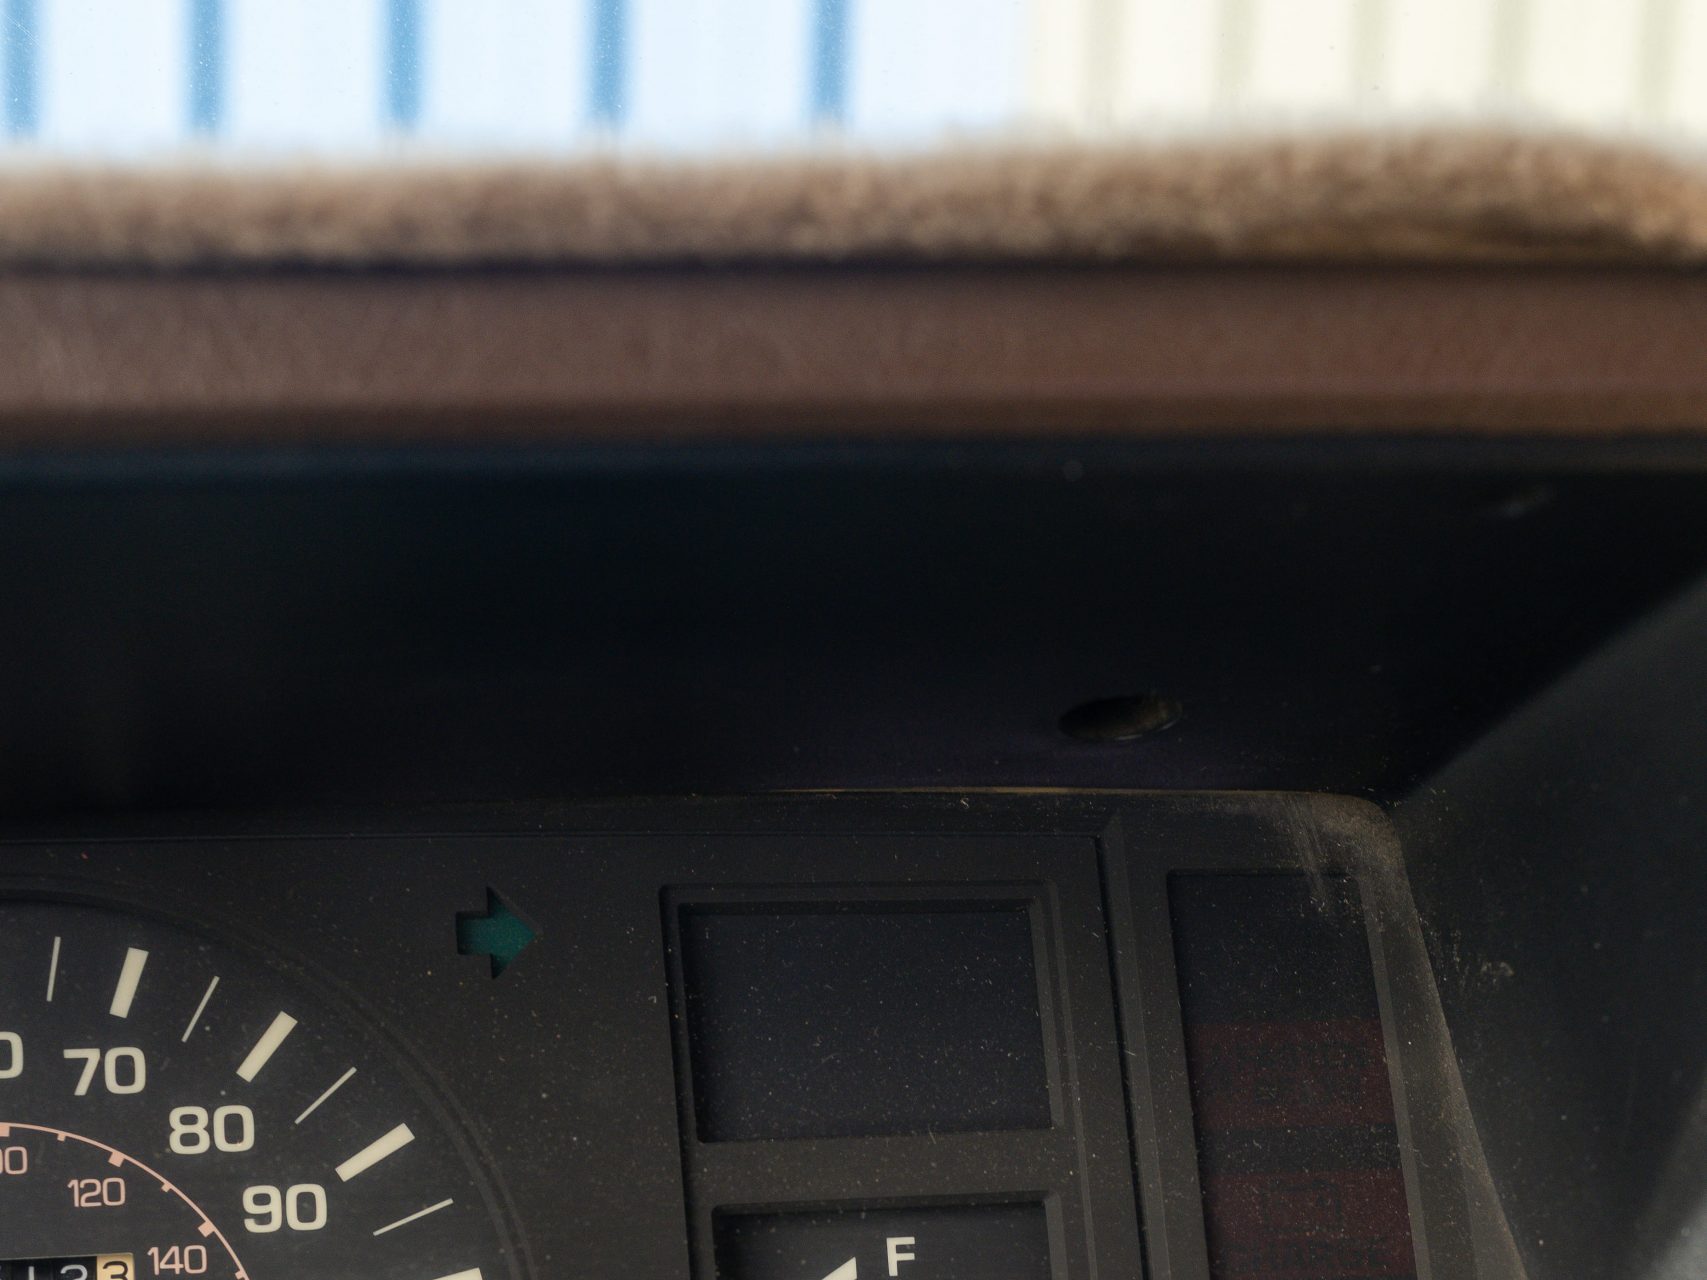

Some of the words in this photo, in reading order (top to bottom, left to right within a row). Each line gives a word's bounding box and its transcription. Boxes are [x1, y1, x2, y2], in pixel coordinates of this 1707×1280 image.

[63, 1046, 146, 1096] 70
[168, 1104, 255, 1155] 80
[0, 1146, 28, 1176] 0
[67, 1177, 126, 1208] 120
[242, 1183, 328, 1234] 90
[147, 1244, 208, 1276] 140
[886, 1236, 916, 1277] F
